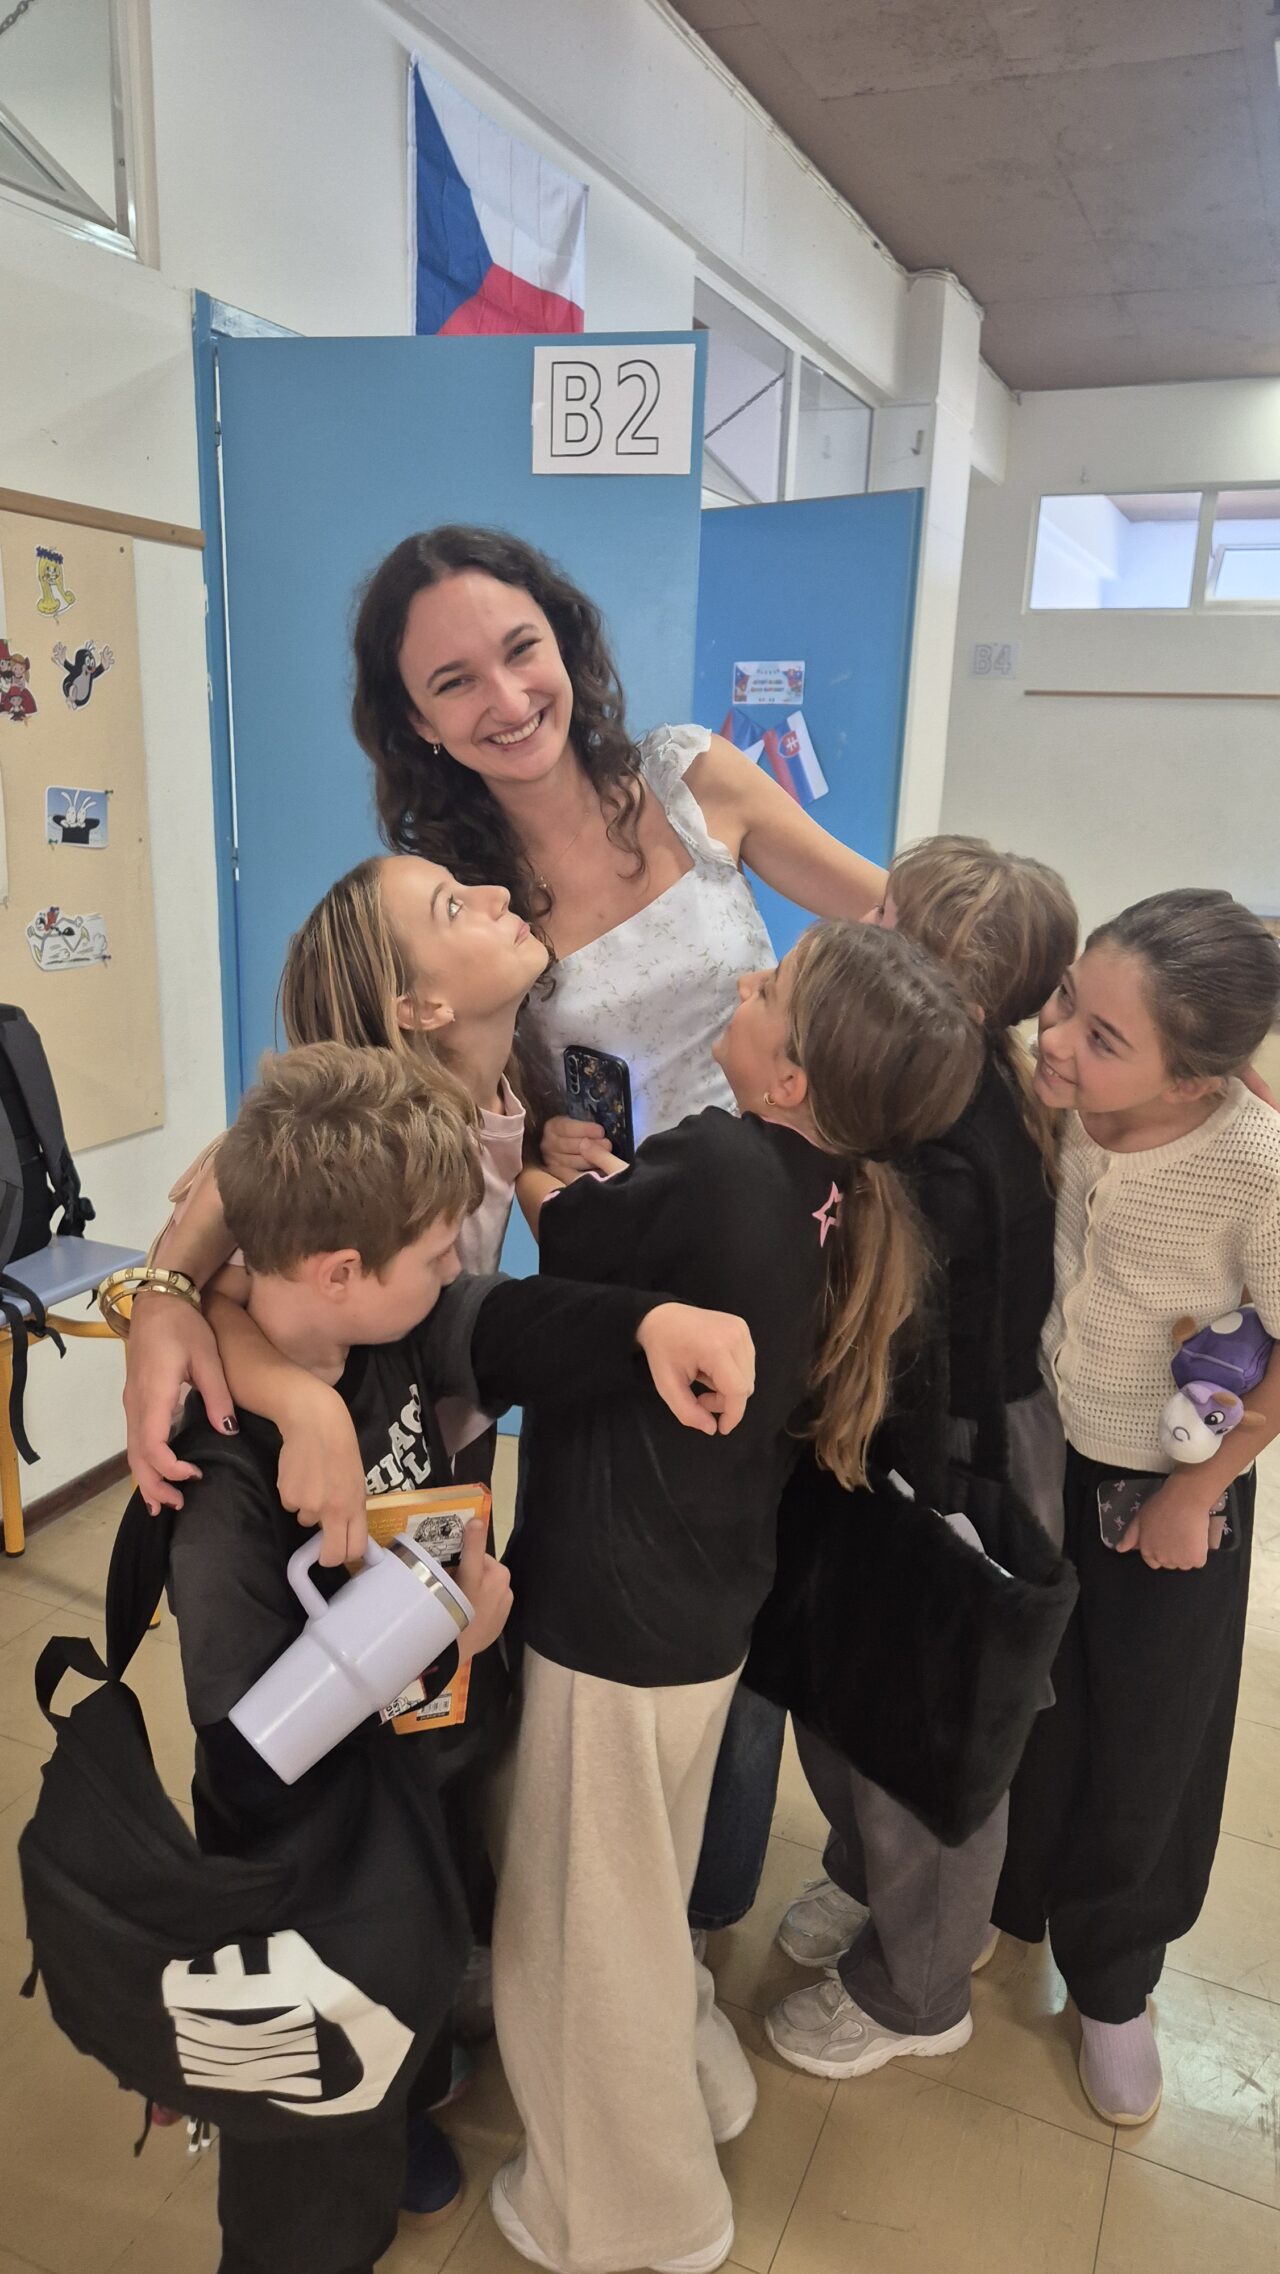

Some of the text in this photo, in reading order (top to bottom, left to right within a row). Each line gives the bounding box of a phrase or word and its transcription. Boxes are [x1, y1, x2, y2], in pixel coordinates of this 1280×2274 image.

[551, 359, 660, 457] B2
[973, 644, 1012, 675] B4
[161, 1929, 322, 2097] NIKE
